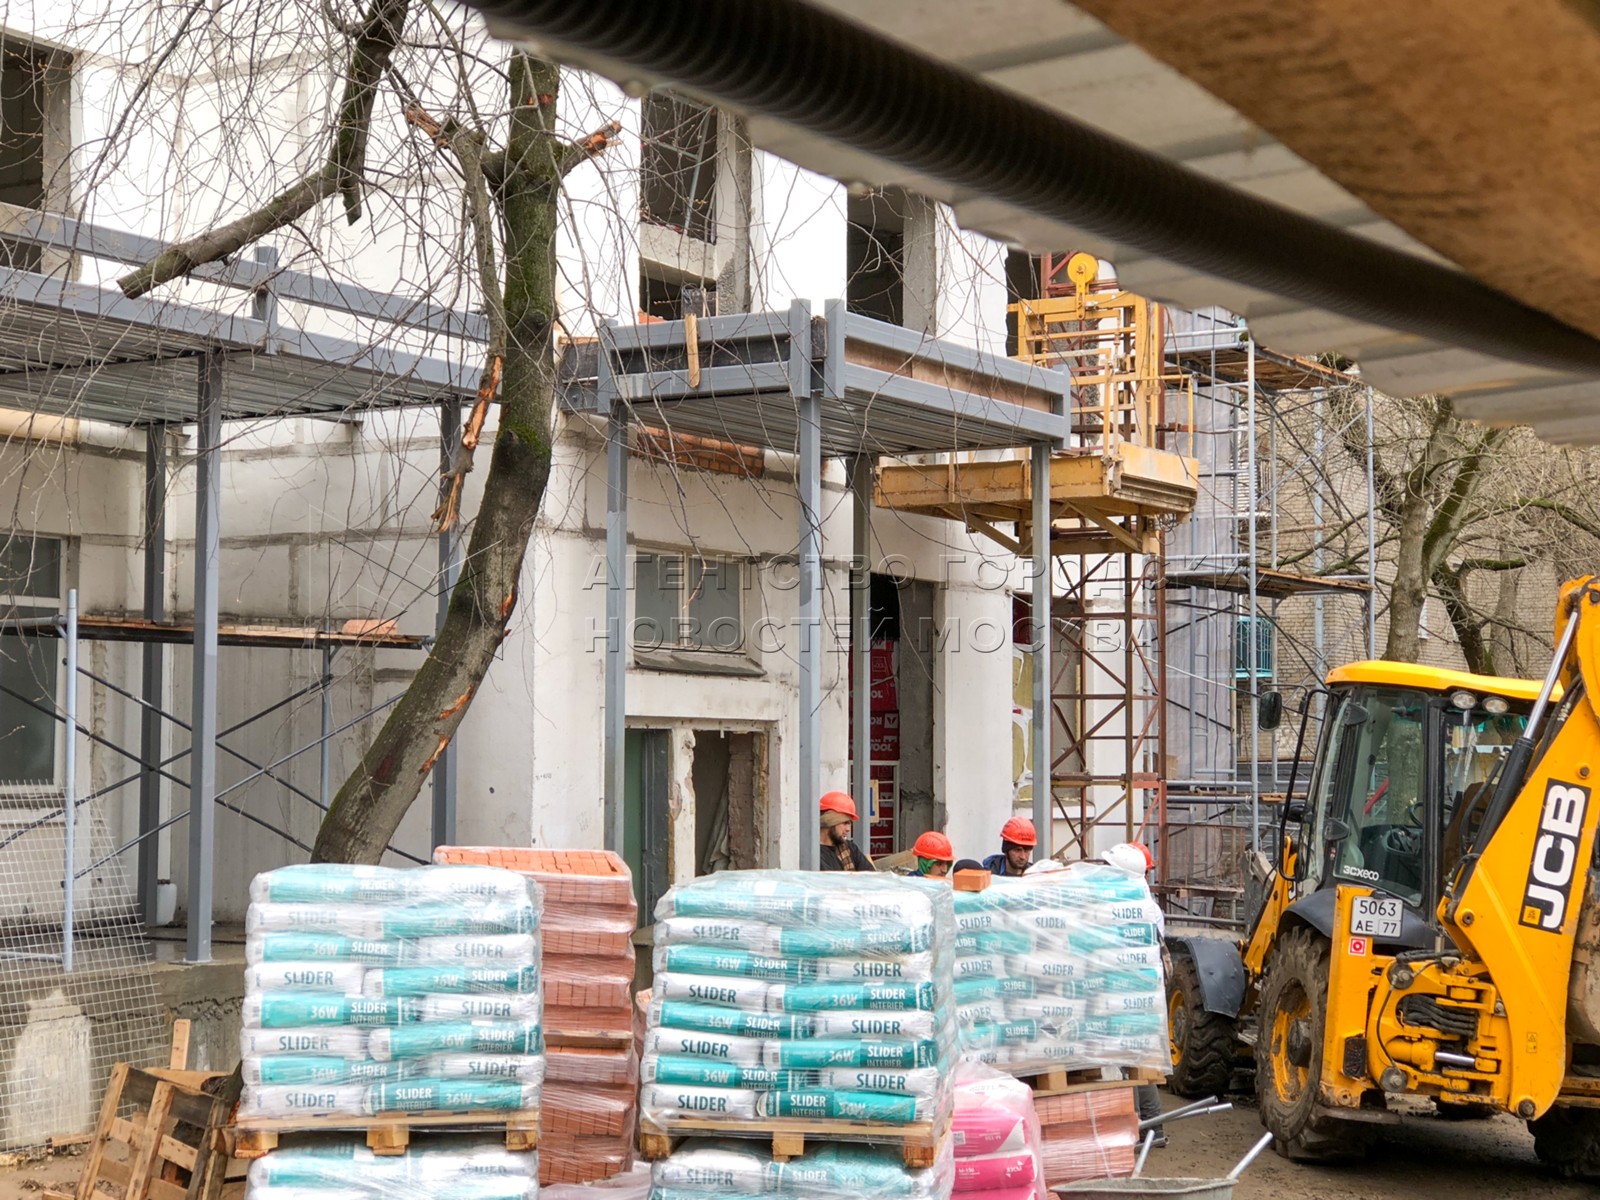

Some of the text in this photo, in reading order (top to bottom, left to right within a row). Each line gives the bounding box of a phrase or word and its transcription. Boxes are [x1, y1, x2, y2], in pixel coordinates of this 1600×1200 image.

[1527, 784, 1586, 929] JCB
[1112, 907, 1143, 920] SLIDER
[1359, 900, 1396, 917] 5063
[288, 911, 337, 925] SLIDER
[960, 915, 992, 931] SLIDER
[1035, 916, 1066, 929] SLIDER
[692, 925, 740, 941] SLIDER
[1122, 927, 1146, 938] SLIDER
[1382, 922, 1397, 934] 77
[313, 943, 338, 956] 36W
[352, 941, 388, 954] SLIDER
[455, 944, 504, 958] SLIDER
[715, 956, 741, 970] 36W
[753, 957, 788, 970] SLIDER
[1117, 953, 1147, 965] SLIDER
[853, 962, 902, 977] SLIDER
[960, 960, 993, 974] SLIDER
[1042, 964, 1074, 977] SLIDER
[284, 971, 334, 985] SLIDER
[472, 969, 508, 982] SLIDER
[1003, 981, 1026, 991] SLIDER
[689, 984, 738, 1003] SLIDER
[870, 989, 905, 1000] SLIDER
[352, 1001, 387, 1014] SLIDER
[832, 995, 858, 1007] 36W
[869, 1001, 904, 1010] INTERIER
[1123, 996, 1154, 1010] SLIDER
[311, 1005, 338, 1019] 36W
[462, 1001, 511, 1017] SLIDER
[1042, 1006, 1073, 1017] SLIDER
[350, 1015, 386, 1025] INTERIER
[707, 1015, 734, 1029] 36W
[745, 1016, 780, 1031] SLIDER
[852, 1019, 902, 1035] SLIDER
[1005, 1026, 1029, 1037] SLIDER
[440, 1034, 466, 1047] 36W
[479, 1030, 515, 1041] SLIDER
[279, 1036, 329, 1051] SLIDER
[681, 1039, 729, 1058] SLIDER
[829, 1050, 855, 1062] 36W
[867, 1046, 903, 1058] SLIDER
[1043, 1047, 1075, 1057] SLIDER
[468, 1061, 518, 1077] SLIDER
[866, 1059, 902, 1067] INTERIER
[351, 1064, 387, 1077] SLIDER
[703, 1069, 730, 1084] 36W
[742, 1069, 778, 1082] SLIDER
[857, 1073, 906, 1090] SLIDER
[396, 1088, 432, 1100] SLIDER
[447, 1093, 473, 1105] 36W
[790, 1094, 826, 1107] SLIDER
[286, 1094, 336, 1109] SLIDER
[678, 1094, 727, 1113] SLIDER
[791, 1108, 825, 1117] INTERIER
[687, 1168, 734, 1186] SLIDER
